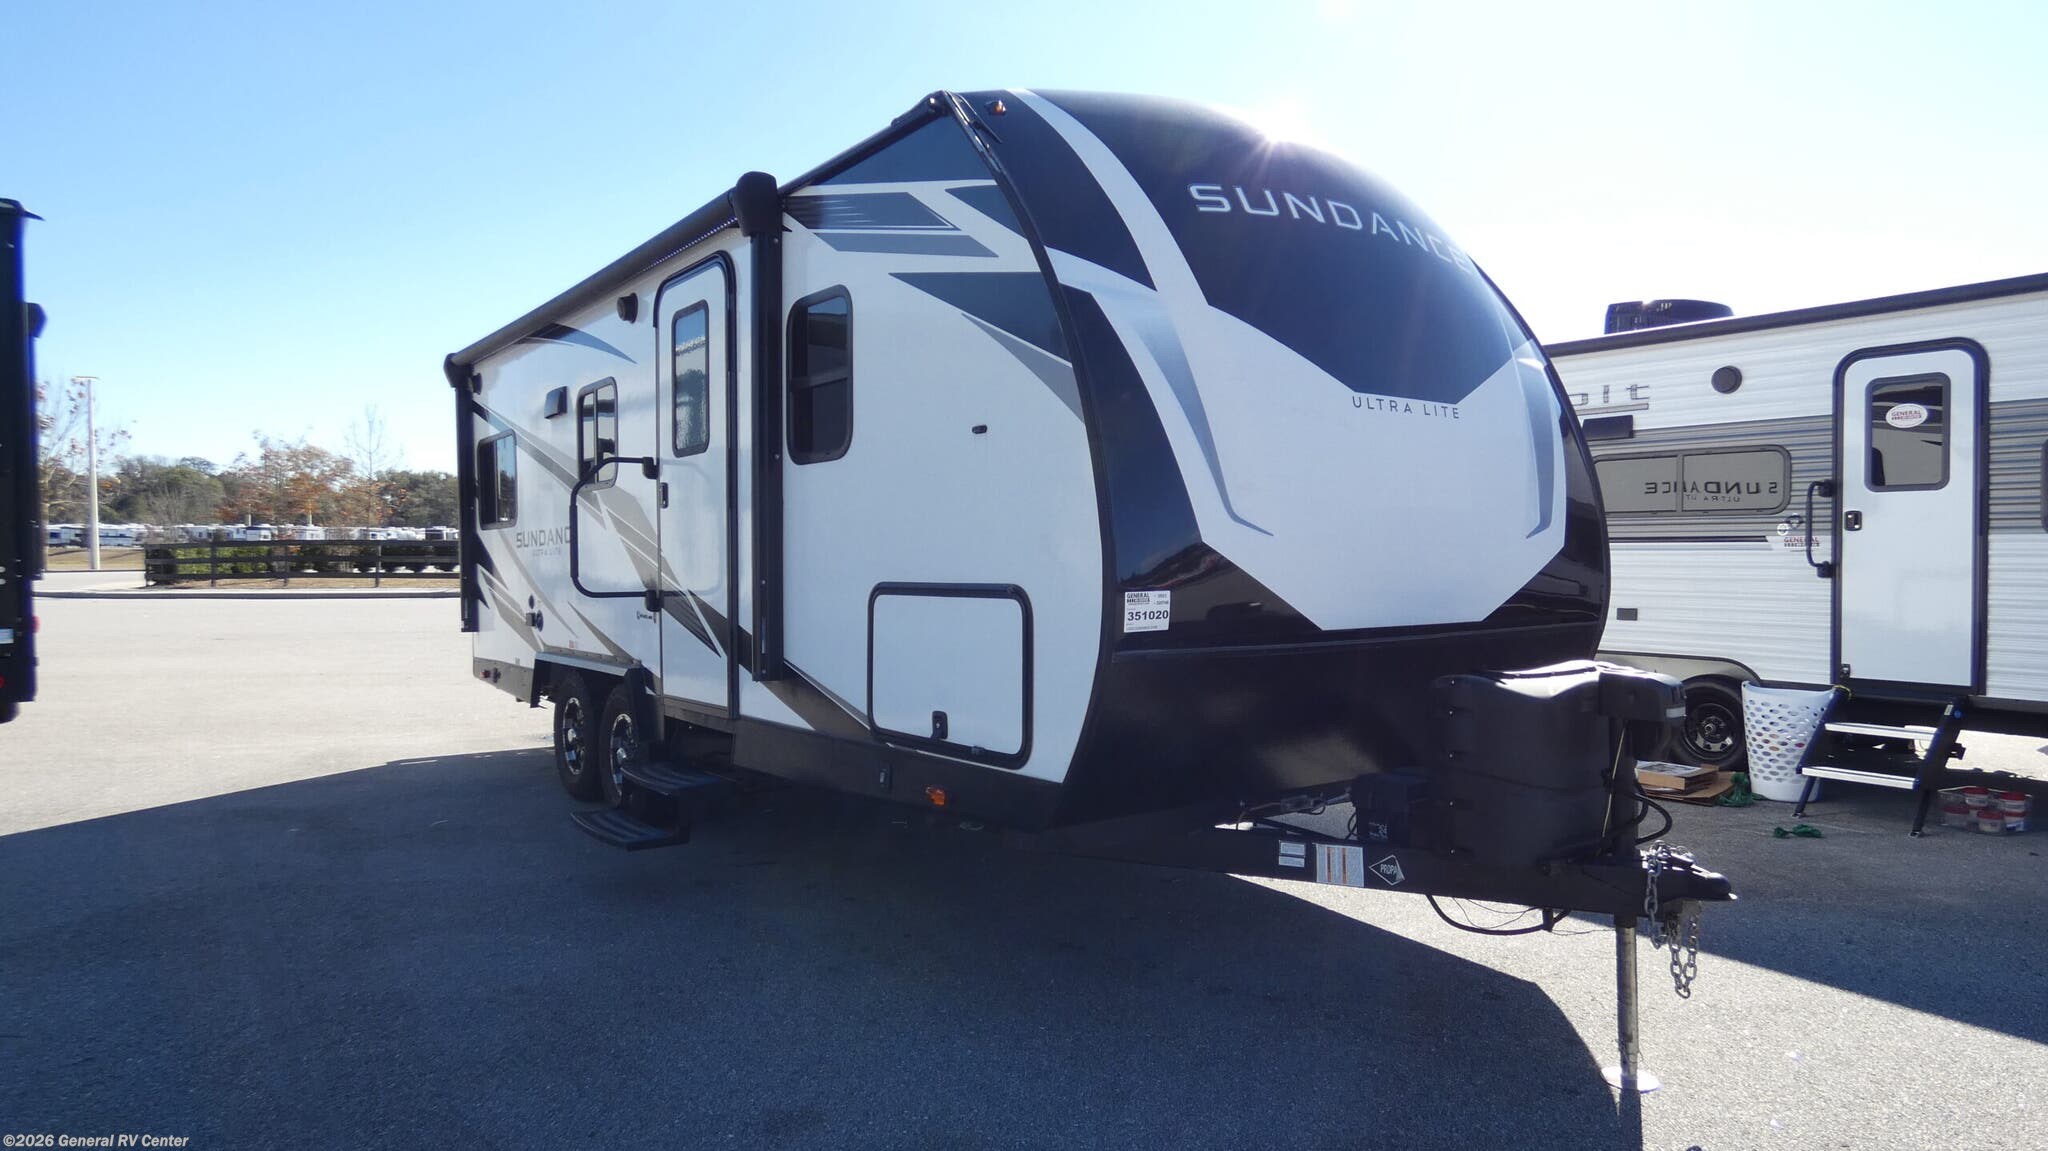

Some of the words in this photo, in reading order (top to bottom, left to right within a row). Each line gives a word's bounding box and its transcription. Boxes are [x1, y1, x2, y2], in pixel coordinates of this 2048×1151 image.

[1188, 183, 1474, 276] SUNDANCE
[1352, 396, 1413, 415] ULTRA
[1423, 404, 1460, 419] LITE
[516, 526, 571, 548] SUNDANC
[1127, 610, 1169, 621] 351020
